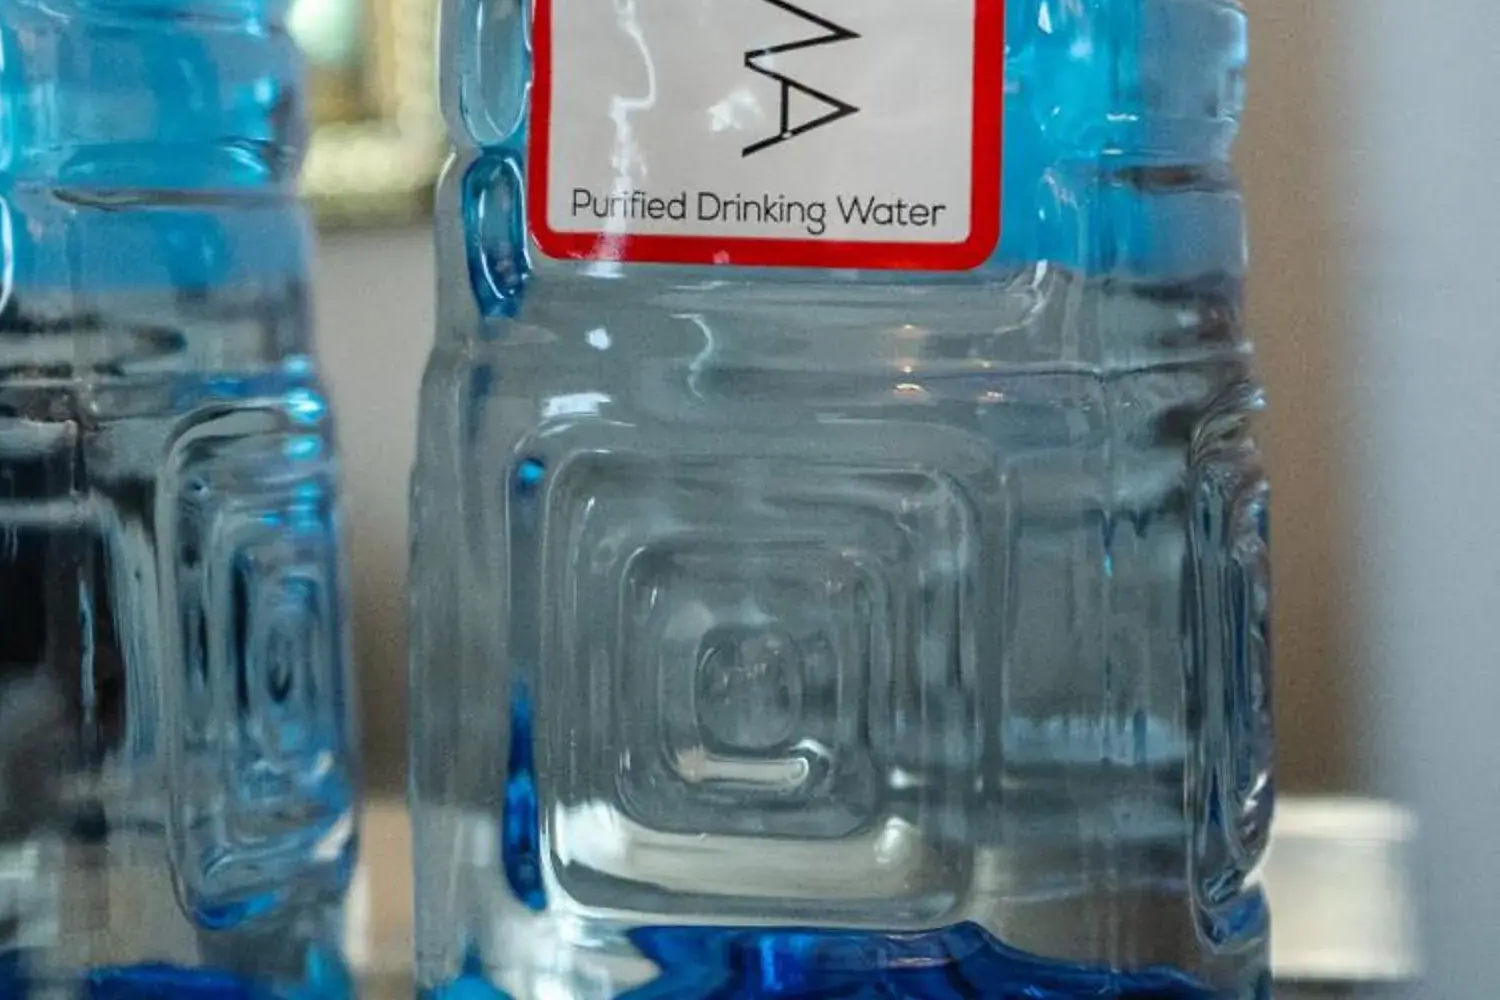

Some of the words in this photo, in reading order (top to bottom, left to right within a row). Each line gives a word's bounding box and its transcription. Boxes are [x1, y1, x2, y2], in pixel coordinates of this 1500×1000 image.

[572, 189, 687, 220] Purified
[698, 192, 827, 235] Drinking
[836, 196, 946, 226] Water
